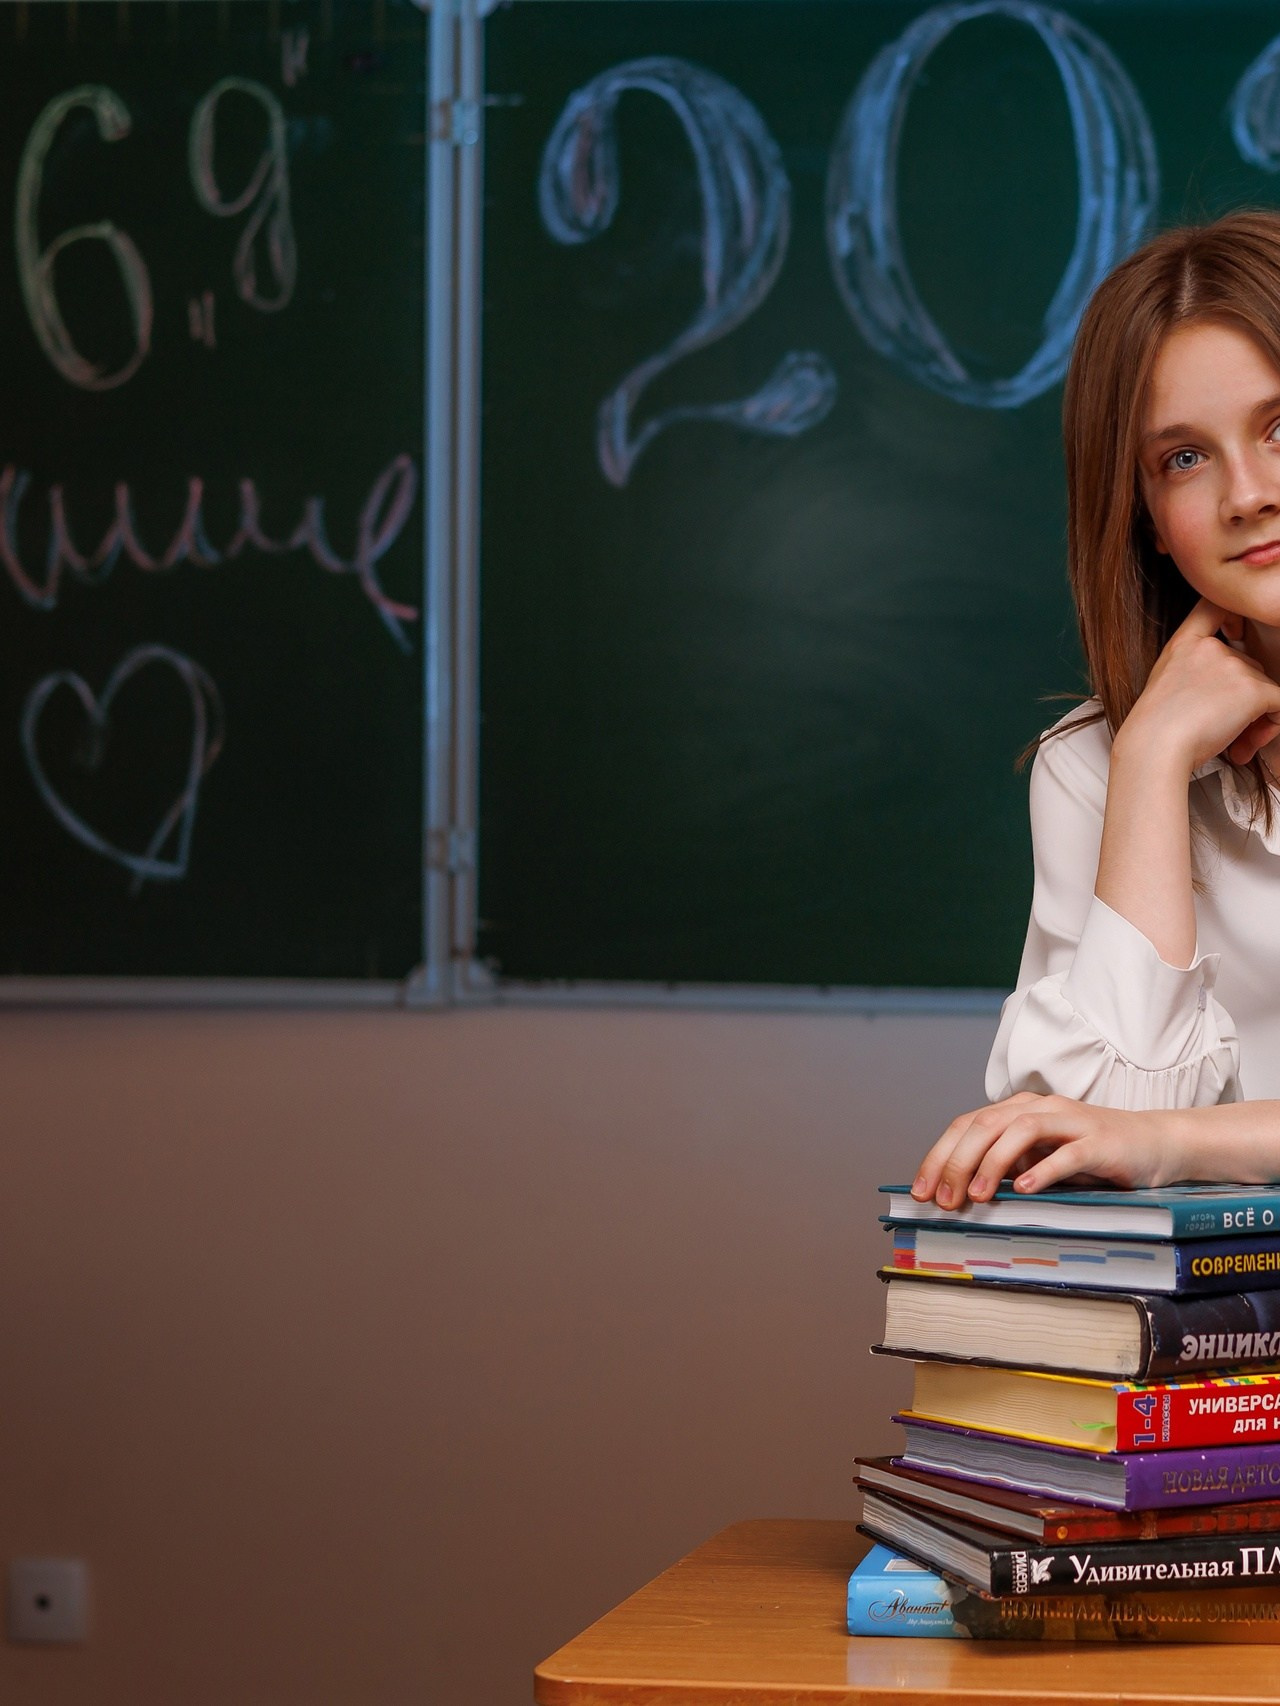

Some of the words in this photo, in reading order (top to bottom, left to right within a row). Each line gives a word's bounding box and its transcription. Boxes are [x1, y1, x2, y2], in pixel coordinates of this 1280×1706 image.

[1223, 1207, 1255, 1229] ВСЁ
[1262, 1209, 1275, 1226] О
[1233, 1415, 1267, 1434] для
[1162, 1466, 1230, 1494] НОВАЯ
[1068, 1553, 1234, 1584] Удивительная
